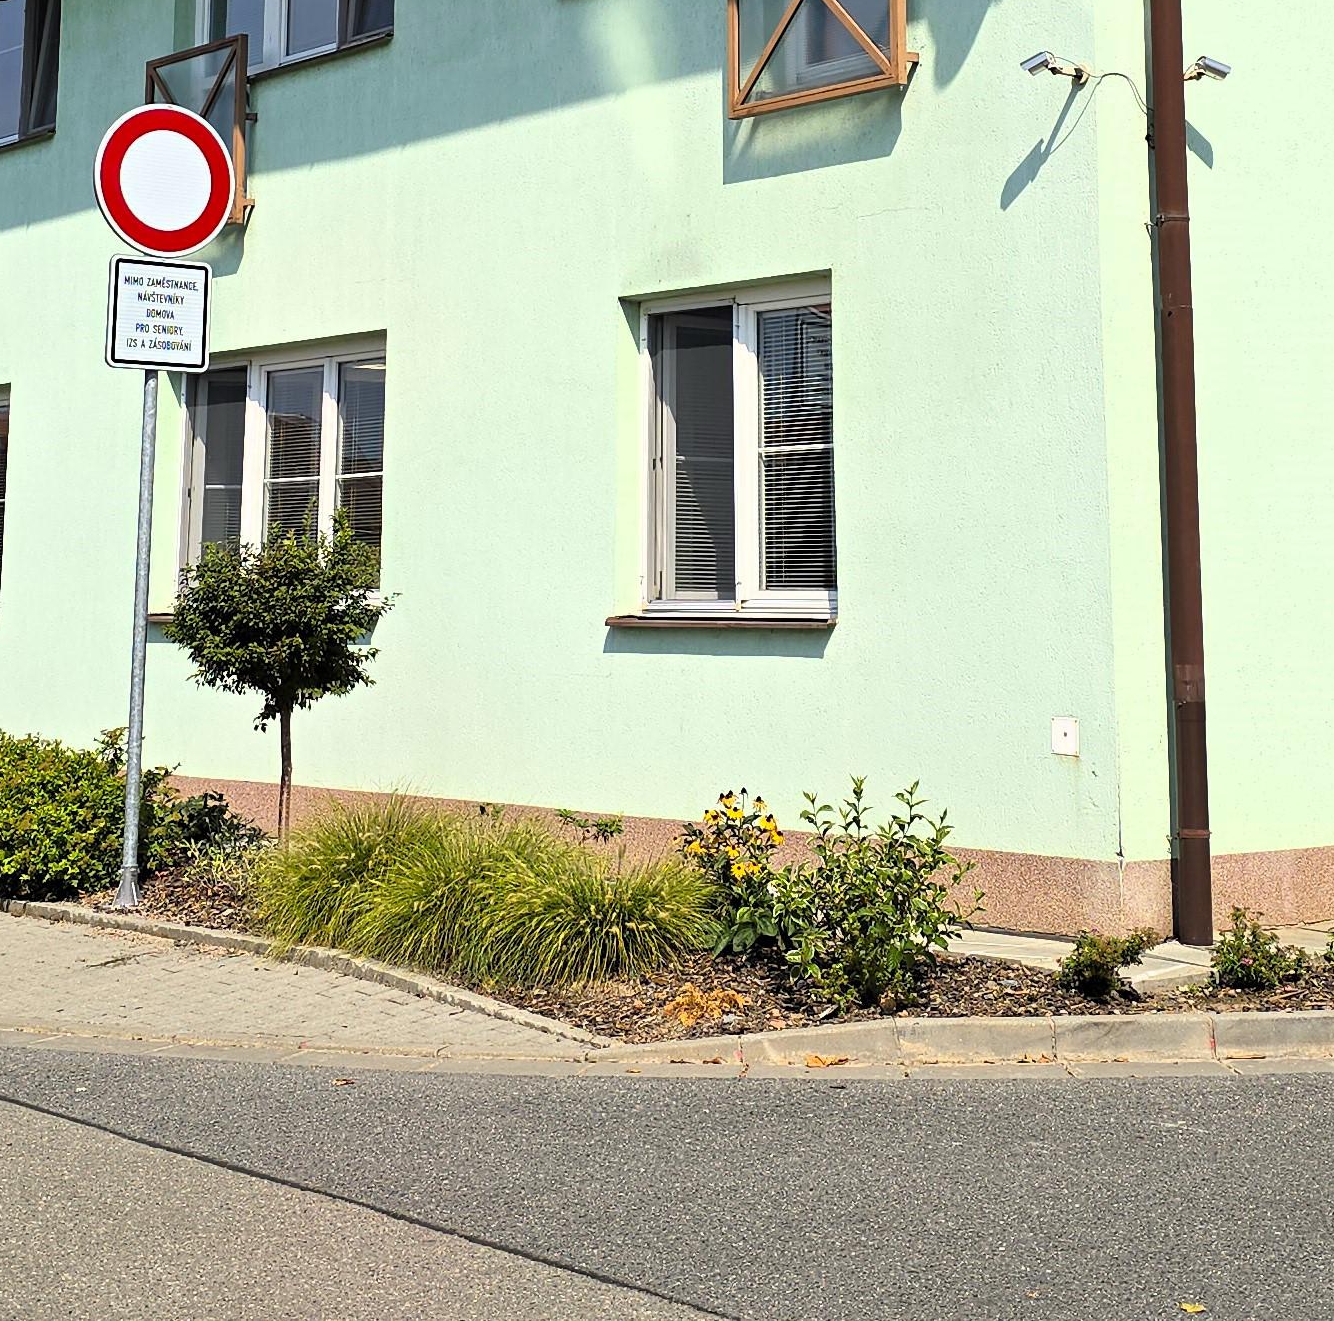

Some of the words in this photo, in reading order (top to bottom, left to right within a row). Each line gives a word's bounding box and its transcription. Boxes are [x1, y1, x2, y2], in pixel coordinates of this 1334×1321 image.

[124, 276, 144, 286] MIMO
[146, 309, 174, 319] DOMOVA
[136, 323, 149, 333] PRO
[127, 338, 137, 347] IZS
[141, 339, 145, 348] A
